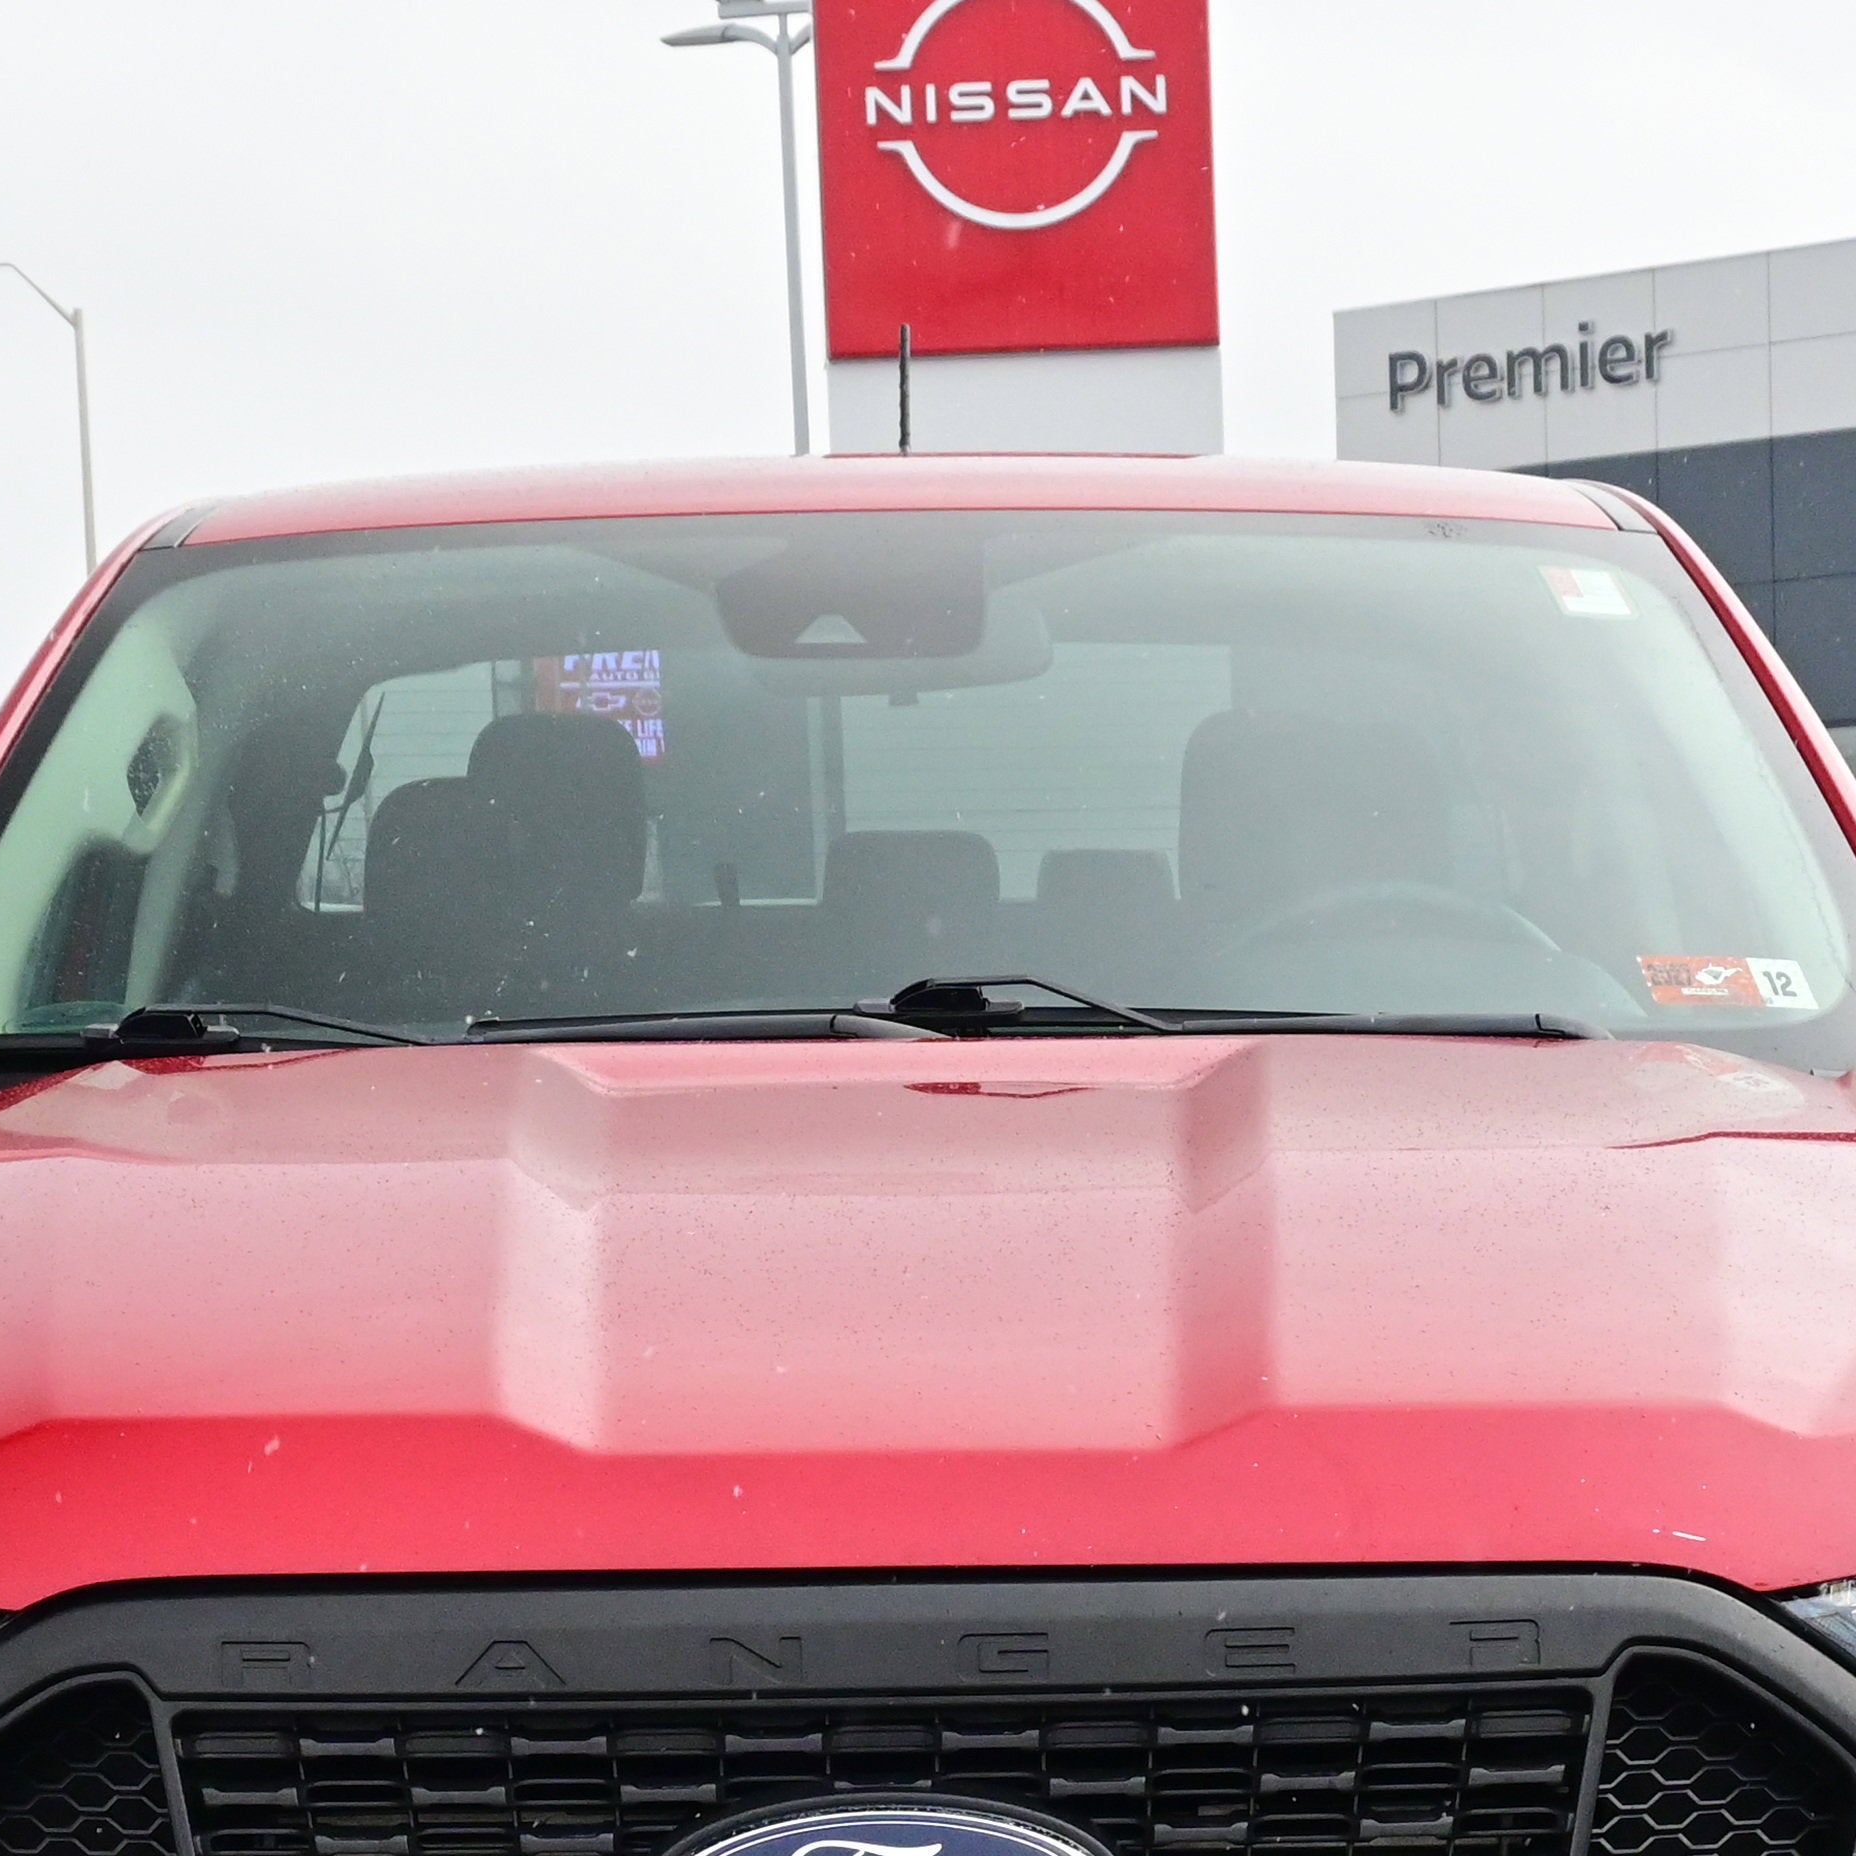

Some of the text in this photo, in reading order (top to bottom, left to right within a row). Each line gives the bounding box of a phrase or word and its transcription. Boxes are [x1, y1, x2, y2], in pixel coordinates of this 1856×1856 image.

[864, 73, 1168, 127] NISSAN
[1387, 319, 1676, 414] Premier
[590, 671, 639, 681] AUTO
[1762, 970, 1798, 997] 12
[219, 1619, 1541, 1687] RANGER
